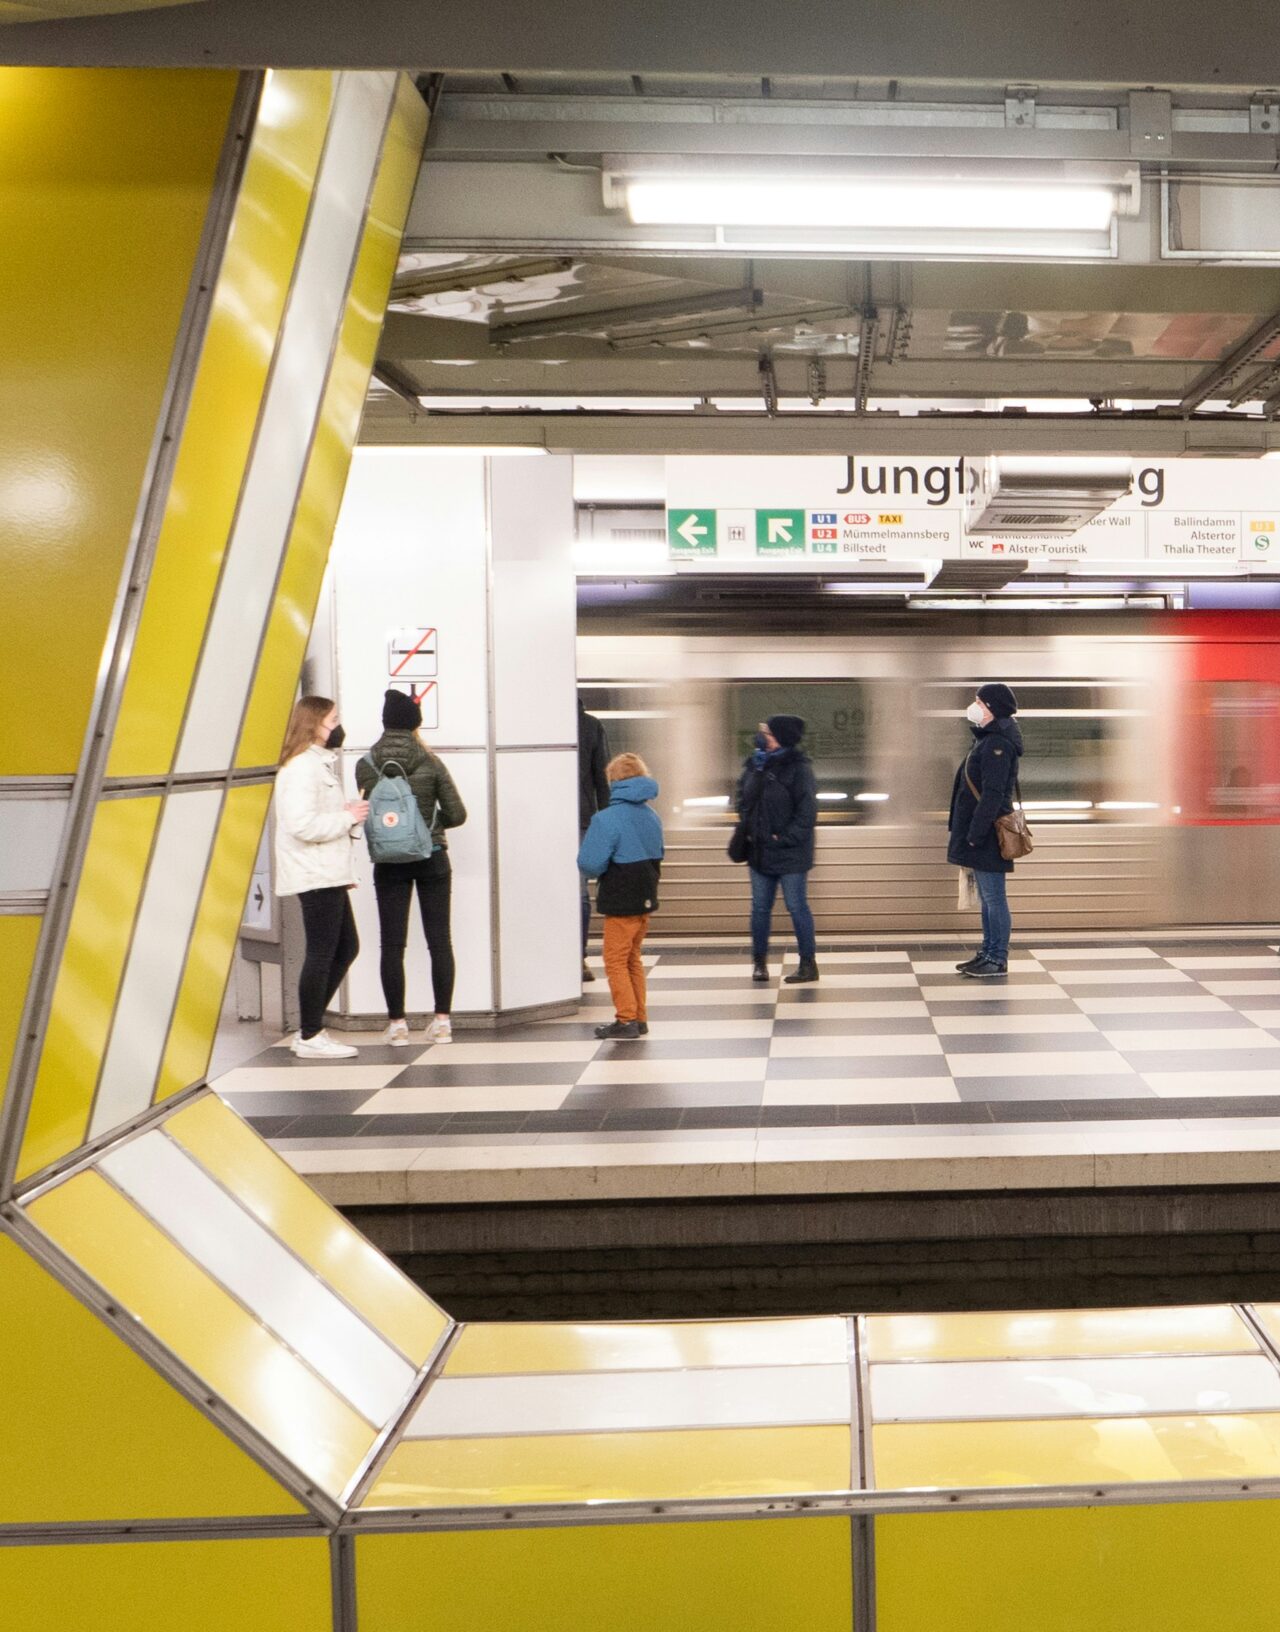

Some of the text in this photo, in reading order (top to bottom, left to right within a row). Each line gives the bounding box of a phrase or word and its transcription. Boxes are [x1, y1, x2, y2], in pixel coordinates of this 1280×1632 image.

[816, 514, 902, 524] U1 BUS TAXI
[1109, 516, 1131, 526] Wall
[1174, 517, 1236, 526] Ballindamm
[816, 528, 950, 541] U2 Mümmelmannsberg
[1191, 531, 1236, 541] Alstertor
[816, 543, 887, 553] U4 Billstedt
[1008, 544, 1088, 554] Alster-Touristik
[1164, 544, 1236, 554] Thalia Theater
